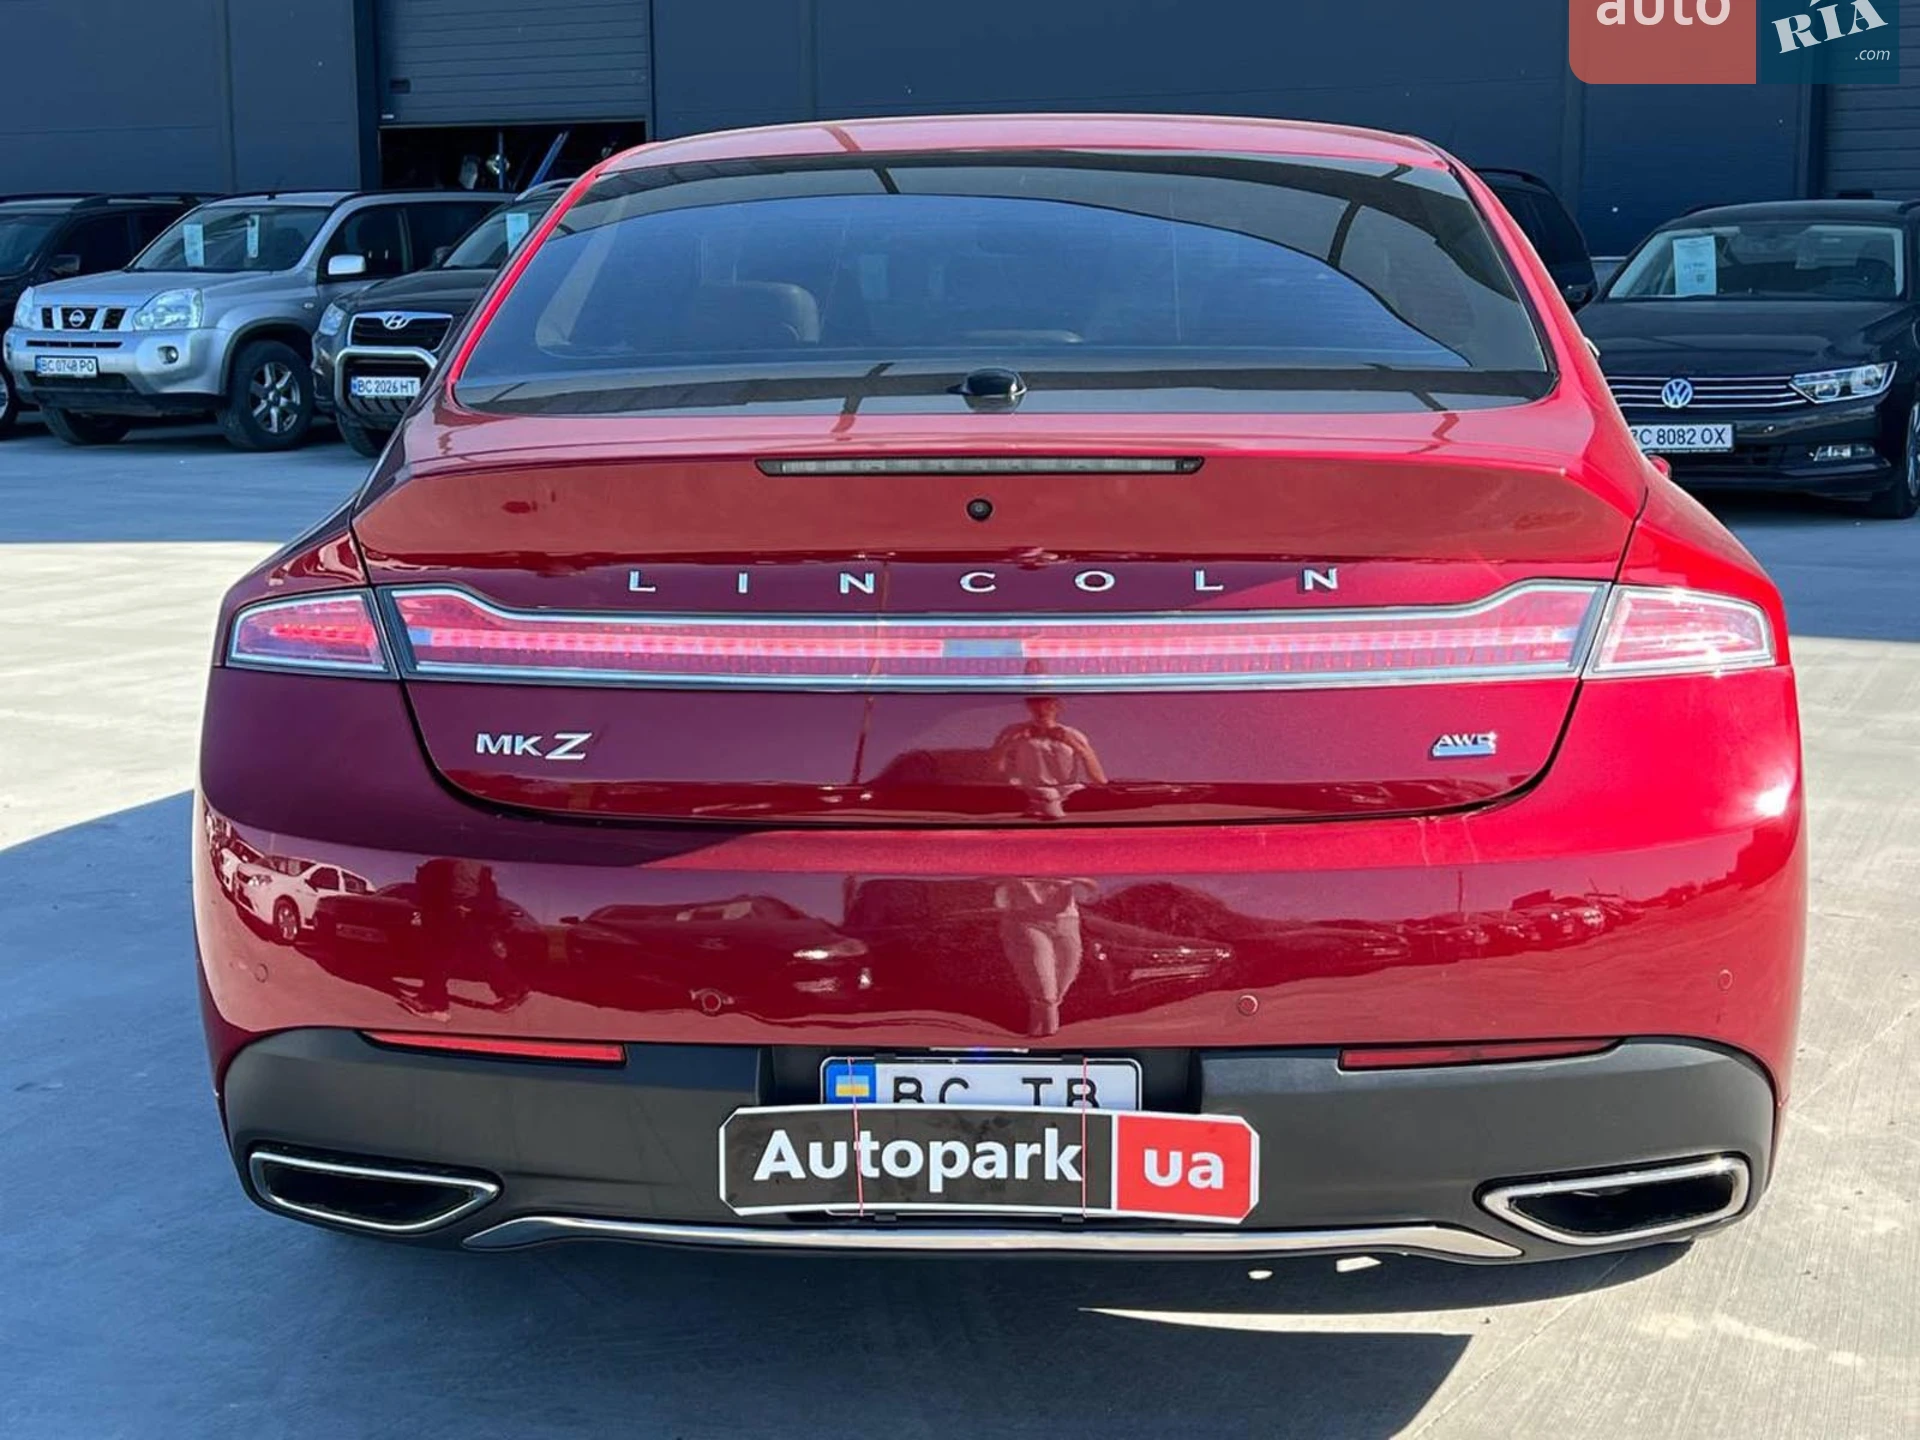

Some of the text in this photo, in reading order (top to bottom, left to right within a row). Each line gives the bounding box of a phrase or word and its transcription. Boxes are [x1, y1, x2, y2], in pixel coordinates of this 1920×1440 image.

[79, 359, 95, 372] PO
[357, 379, 416, 393] BC 2026 HT
[1656, 428, 1697, 445] 8082
[1700, 427, 1726, 445] OX
[627, 567, 1339, 594] LINCOLN
[753, 1128, 1225, 1193] Autopark ua
